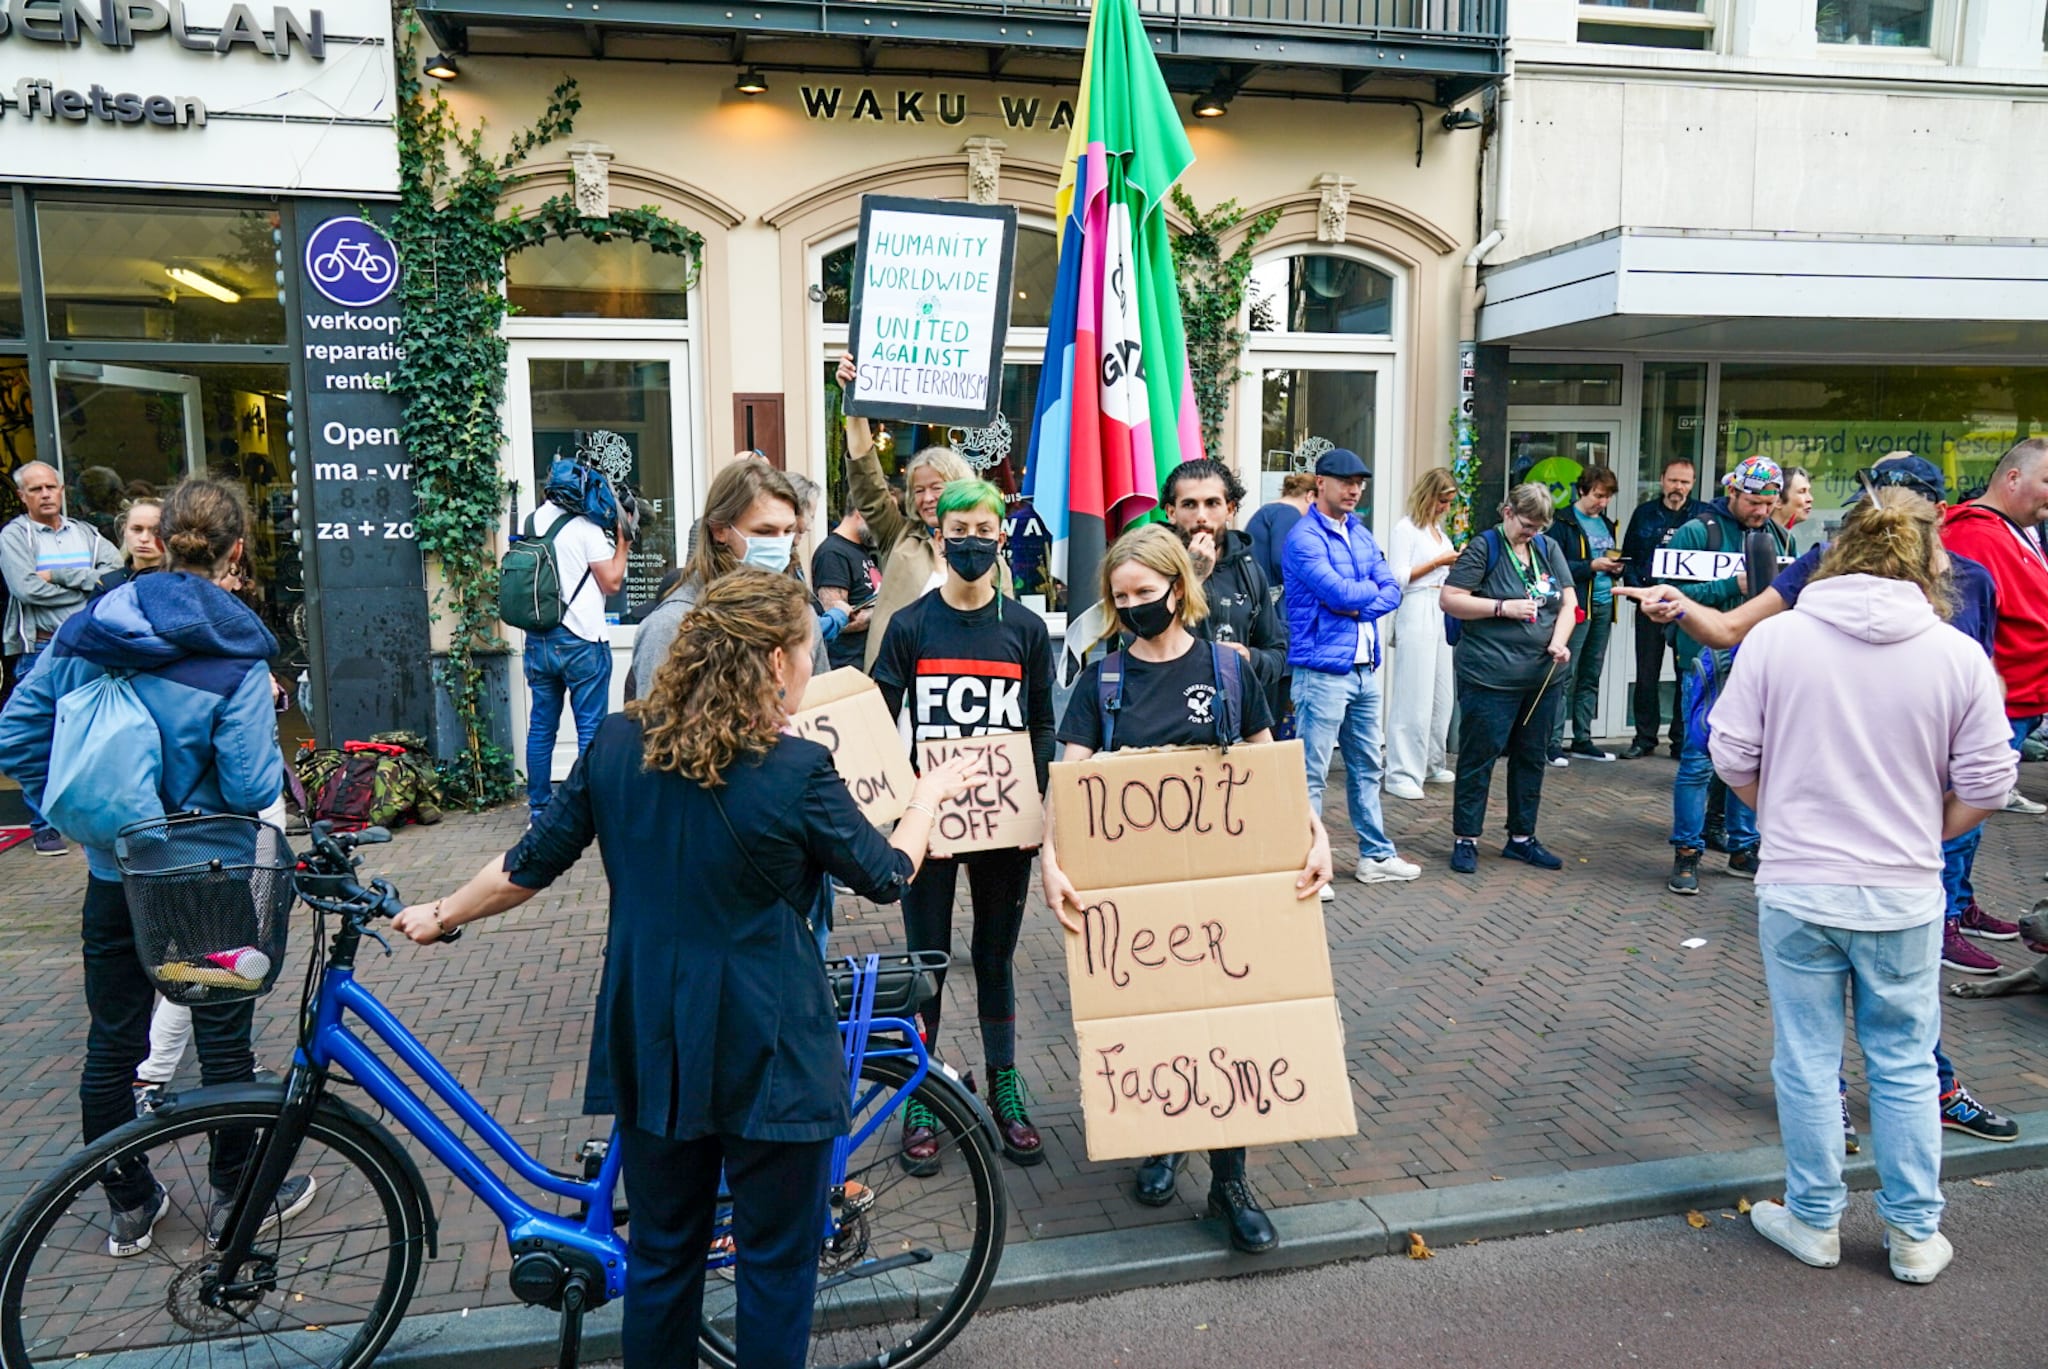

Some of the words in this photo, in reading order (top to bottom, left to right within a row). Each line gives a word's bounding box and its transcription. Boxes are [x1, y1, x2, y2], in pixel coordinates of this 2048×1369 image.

[0, 0, 326, 58] ENPLAN
[801, 86, 966, 125] WAKU
[869, 264, 989, 292] WORLDWIDE
[306, 311, 402, 335] verkoop
[305, 342, 407, 364] reparatie
[325, 371, 392, 390] rental
[859, 364, 911, 395] STATE
[916, 368, 988, 400] TERRORISM
[323, 422, 400, 451] Open
[1735, 428, 1772, 453] Dit
[1780, 428, 1845, 459] pand
[1855, 430, 1932, 454] wordt
[1941, 429, 2029, 455] besch
[314, 462, 359, 480] ma
[384, 463, 413, 480] vr
[317, 522, 349, 539] za
[383, 522, 415, 539] zo
[1662, 551, 1696, 577] IK
[916, 676, 1023, 727] FCK
[846, 770, 896, 810] OM
[938, 778, 1021, 814] UCK
[939, 809, 1001, 840] OFF
